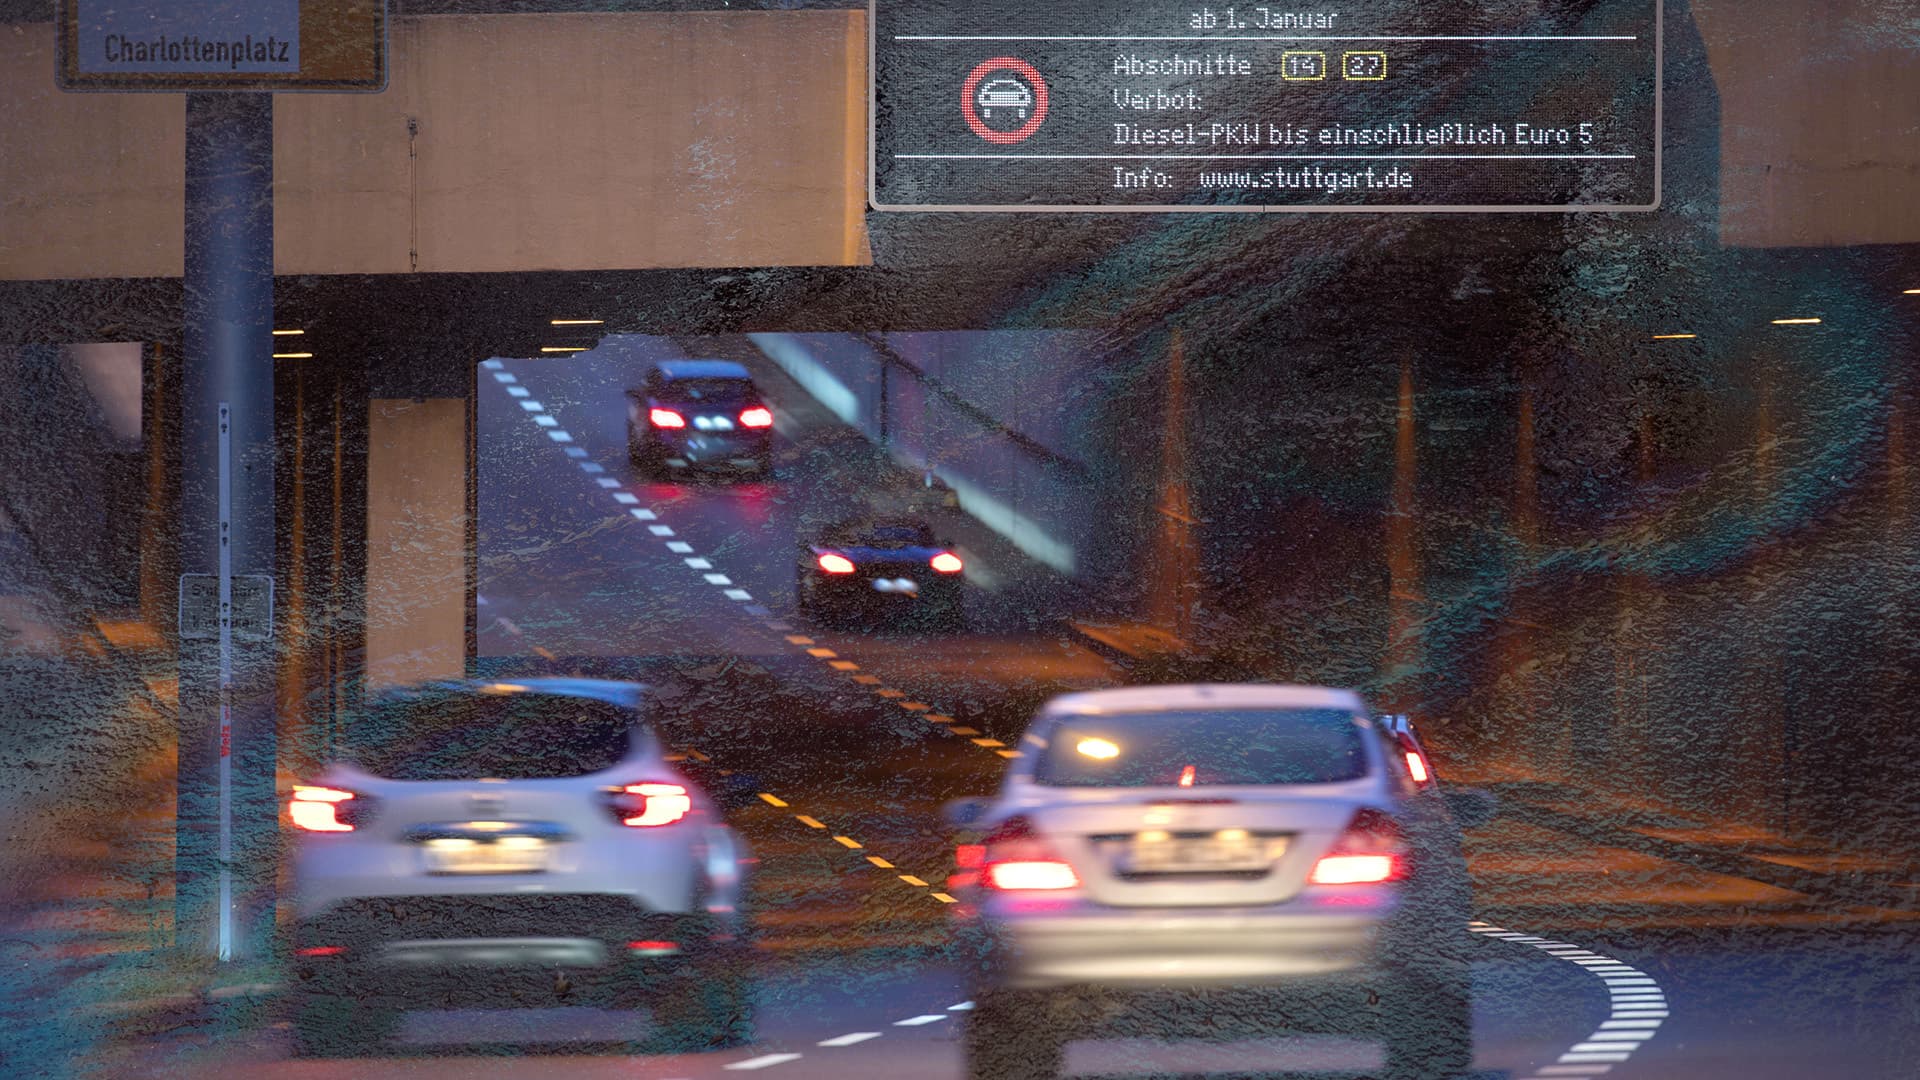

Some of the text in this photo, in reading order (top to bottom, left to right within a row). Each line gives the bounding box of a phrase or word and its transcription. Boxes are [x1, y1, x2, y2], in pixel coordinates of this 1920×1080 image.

[1190, 8, 1338, 29] ab 1. Januar
[104, 33, 290, 70] Charlottenplatz
[1113, 54, 1379, 75] Abschnitte 14 27
[1113, 89, 1202, 110] Verbot:
[1113, 123, 1593, 145] Diesel-PKW bis einschließlich Euro 5
[1113, 167, 1413, 193] Info: www.stuttgart.de
